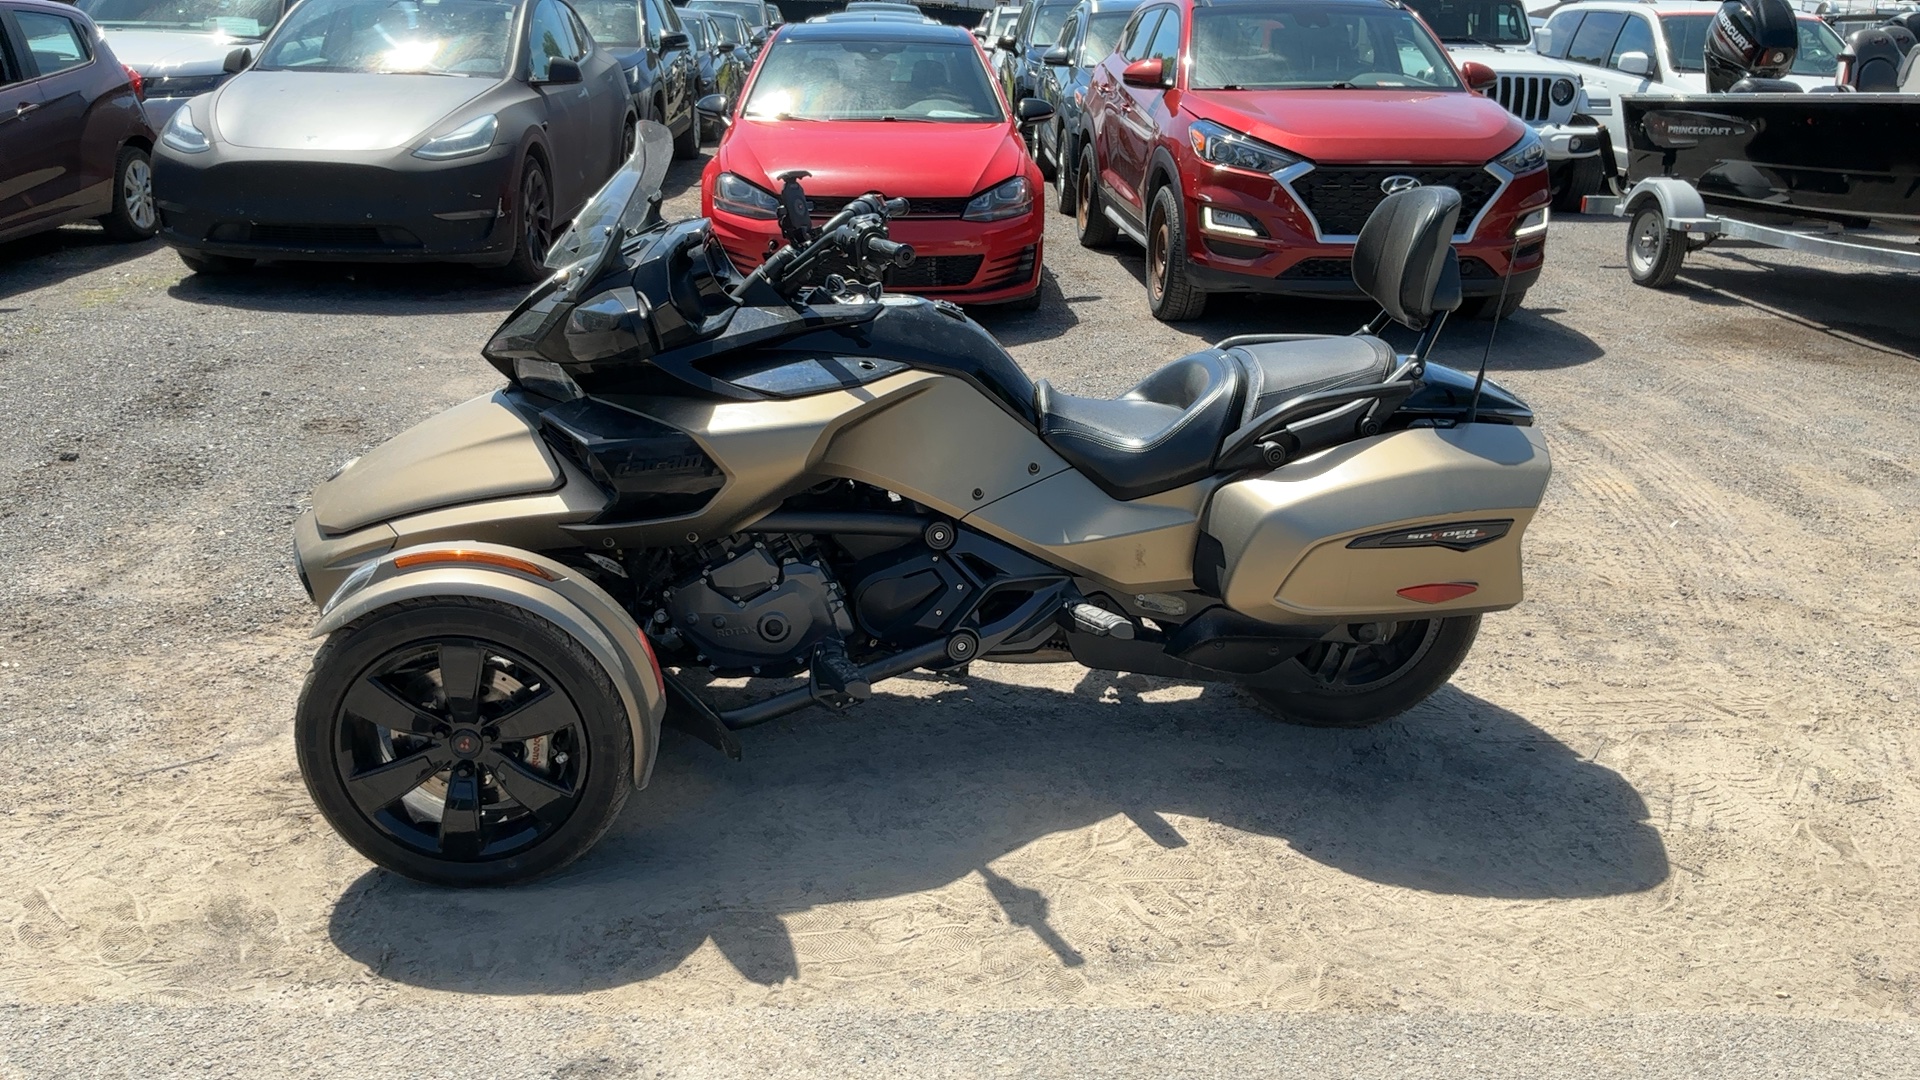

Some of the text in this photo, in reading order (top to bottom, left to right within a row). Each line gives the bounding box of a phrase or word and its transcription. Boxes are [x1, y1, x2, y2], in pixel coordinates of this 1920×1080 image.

[1717, 8, 1754, 51] MERCURY
[1667, 125, 1732, 136] PRINCECRAFT
[1407, 528, 1479, 540] SPYDER
[716, 625, 758, 639] ROTAX
